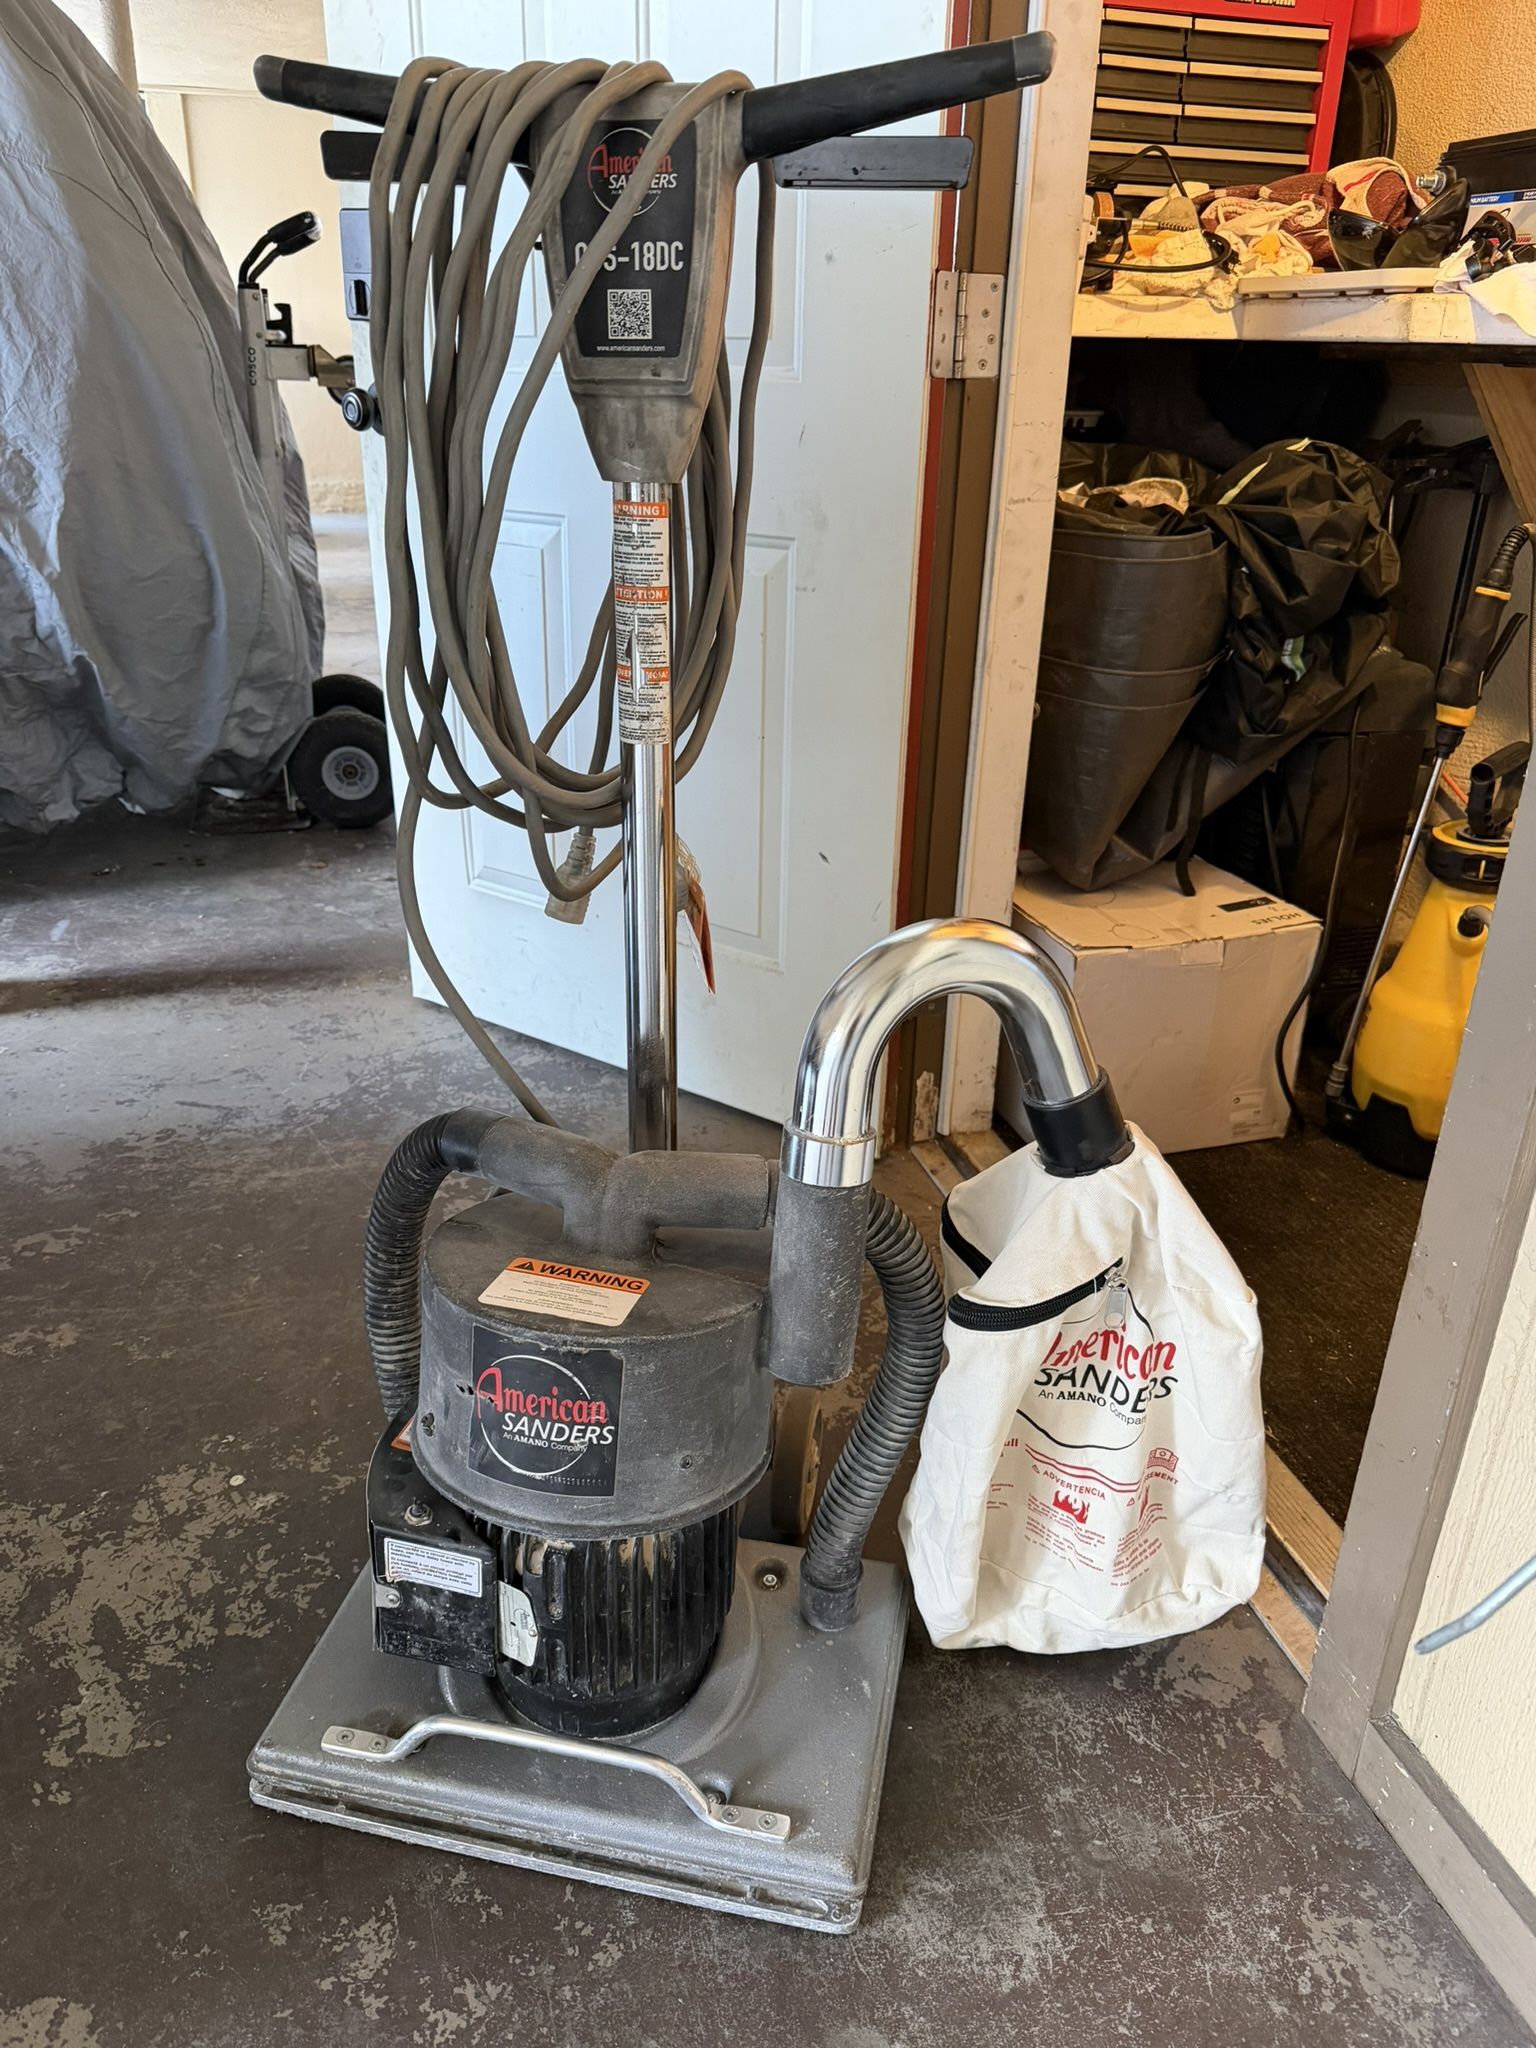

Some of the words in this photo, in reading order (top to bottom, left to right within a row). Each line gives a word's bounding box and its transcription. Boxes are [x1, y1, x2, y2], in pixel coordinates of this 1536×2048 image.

[608, 173, 678, 189] SAERS
[540, 1263, 644, 1290] WARNING
[475, 1366, 607, 1424] American
[1039, 1389, 1054, 1399] An
[1056, 1390, 1107, 1407] AMANO
[502, 1412, 615, 1445] SANDERS
[503, 1431, 513, 1440] An
[515, 1434, 549, 1448] AMANO
[1042, 1469, 1106, 1500] ADVERTENCIA
